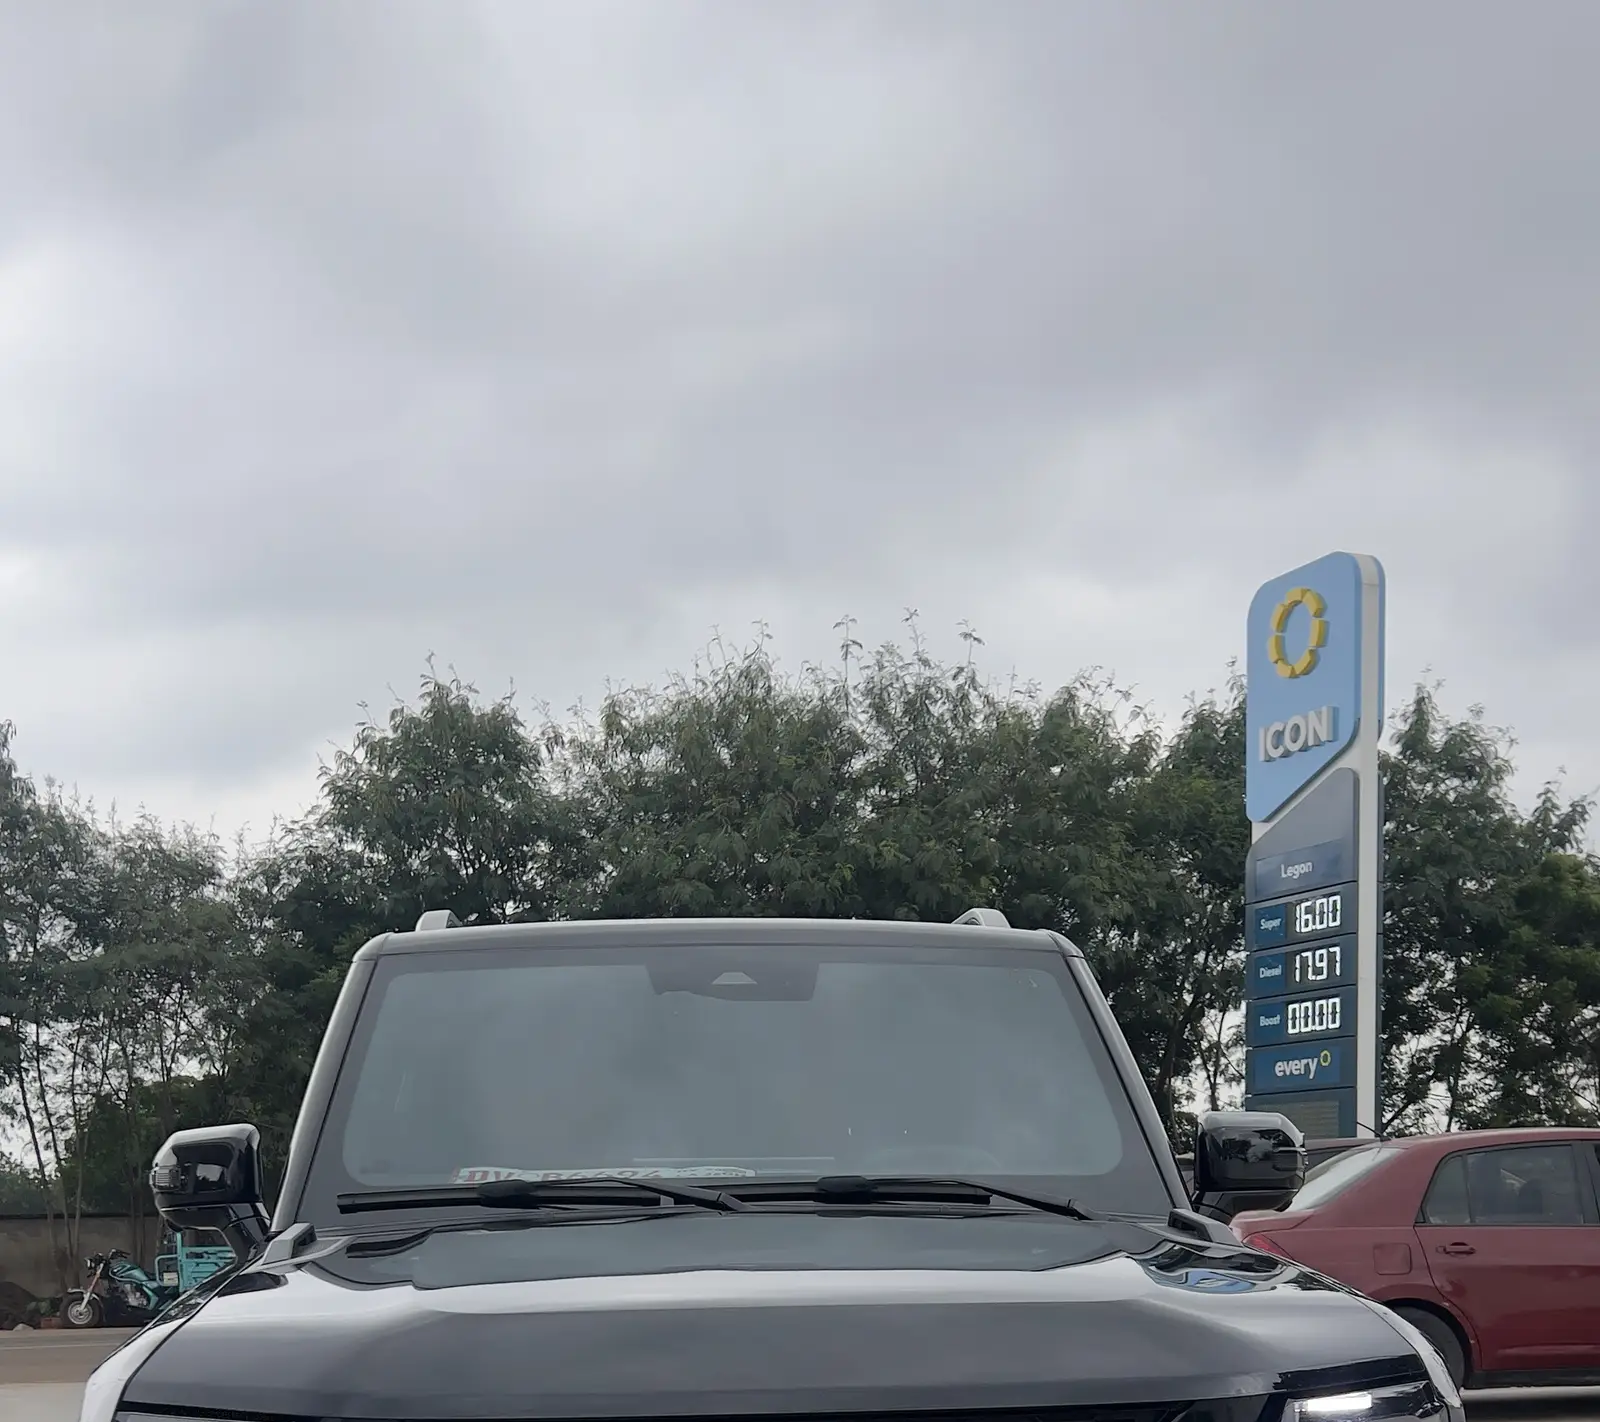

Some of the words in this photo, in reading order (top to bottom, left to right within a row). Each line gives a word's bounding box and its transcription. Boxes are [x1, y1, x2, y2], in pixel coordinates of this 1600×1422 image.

[1258, 706, 1334, 762] ICON
[1280, 861, 1313, 879] Legon
[1259, 917, 1282, 932] Super
[1259, 964, 1282, 978] Diesel
[1259, 1013, 1281, 1027] Boost
